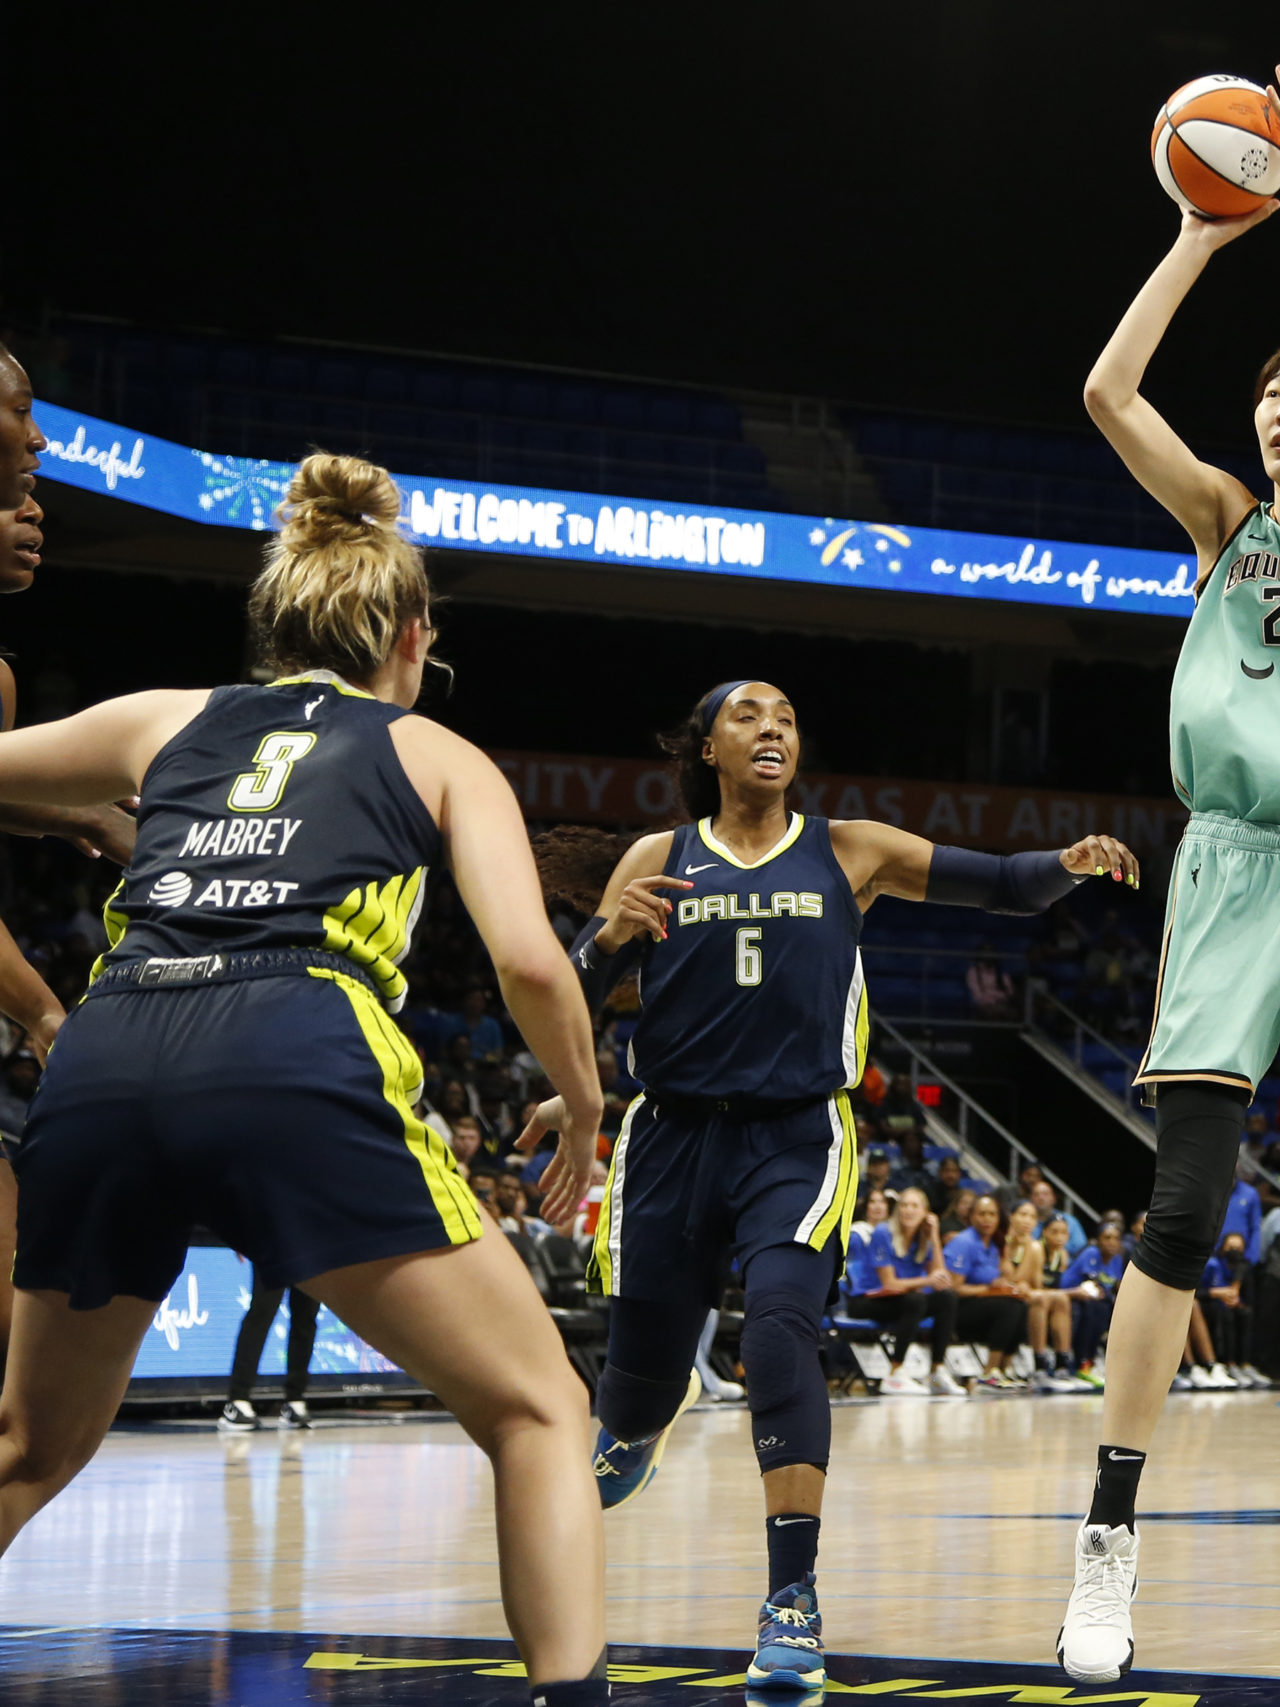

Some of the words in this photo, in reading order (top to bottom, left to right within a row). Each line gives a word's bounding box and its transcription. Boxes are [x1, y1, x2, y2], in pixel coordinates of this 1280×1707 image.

[411, 488, 566, 548] WELCOME
[567, 514, 594, 545] TO
[594, 506, 765, 567] ARLINGTON
[931, 558, 956, 575] a
[960, 543, 1062, 584] world
[1066, 559, 1102, 604] of
[227, 731, 318, 814] 3
[178, 818, 303, 859] MABREY
[193, 879, 299, 908] AT&T
[678, 891, 823, 926] DALLAS
[735, 926, 763, 987] 6
